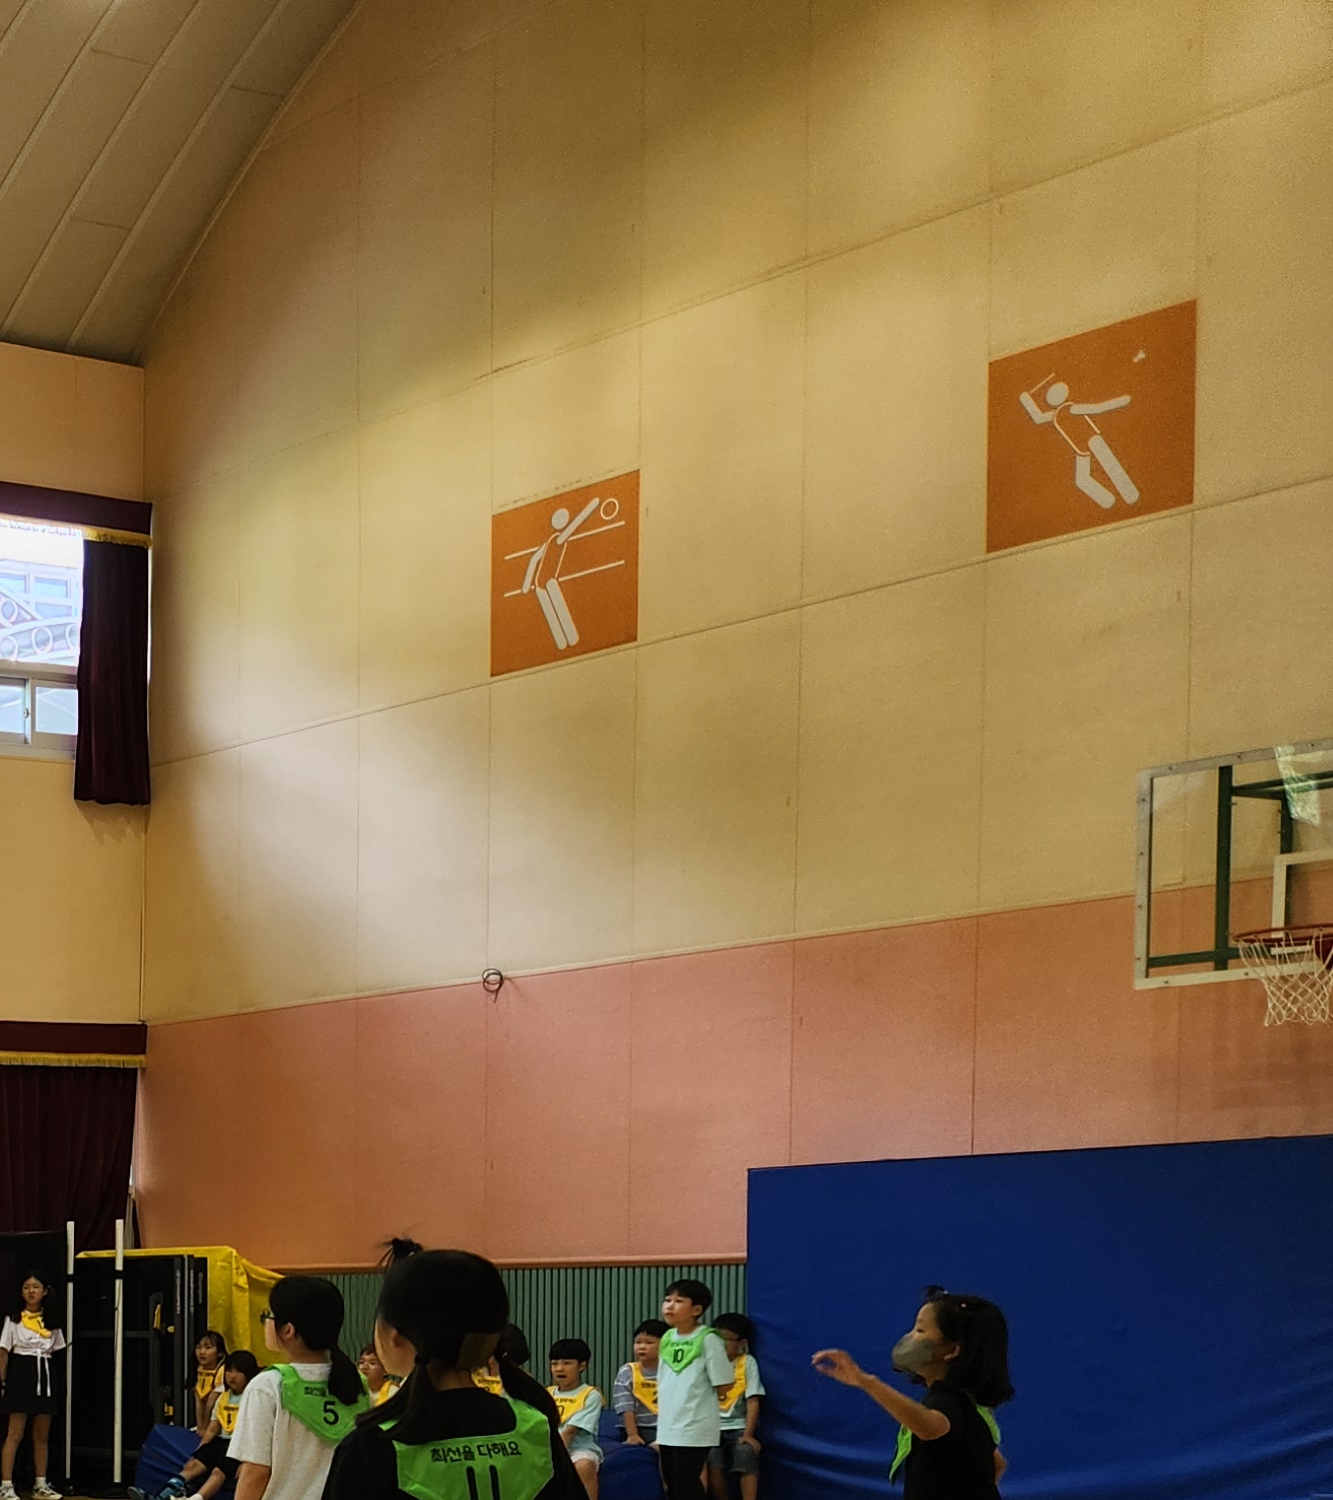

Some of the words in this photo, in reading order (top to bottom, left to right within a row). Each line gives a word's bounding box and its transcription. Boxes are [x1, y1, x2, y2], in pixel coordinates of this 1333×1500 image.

[672, 1348, 685, 1363] 10
[323, 1401, 339, 1424] 5
[431, 1446, 475, 1463] 최선을
[477, 1441, 522, 1459] 다해요
